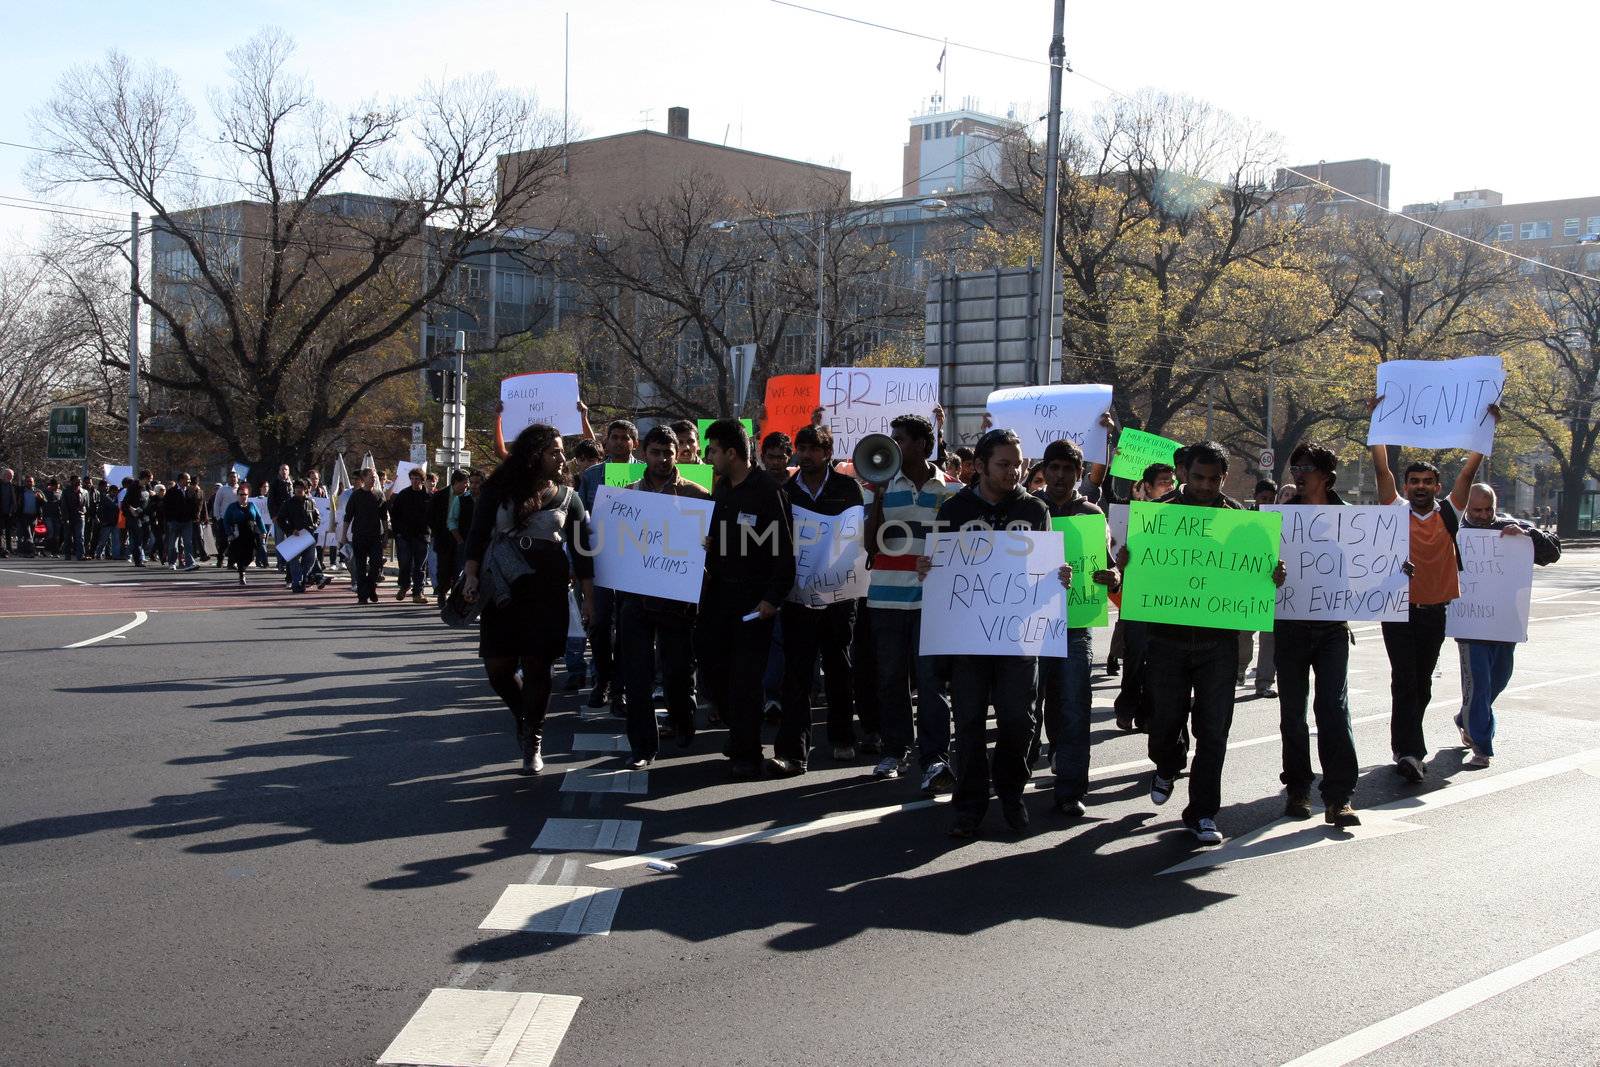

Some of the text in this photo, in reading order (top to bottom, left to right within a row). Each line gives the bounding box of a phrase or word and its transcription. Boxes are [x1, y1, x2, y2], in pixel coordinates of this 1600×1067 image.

[793, 384, 813, 397] ARE
[826, 370, 937, 415] $12 BILLION
[529, 402, 545, 412] NOT
[1034, 404, 1058, 418] FOR
[1378, 380, 1507, 429] DIGNITY
[1174, 515, 1214, 538] ARE
[929, 537, 994, 568] END
[1299, 550, 1409, 580] POISON
[949, 571, 1045, 611] RACIST
[1188, 576, 1209, 591] OF
[1140, 593, 1200, 610] INDIAN
[1309, 585, 1409, 615] EVERYONE
